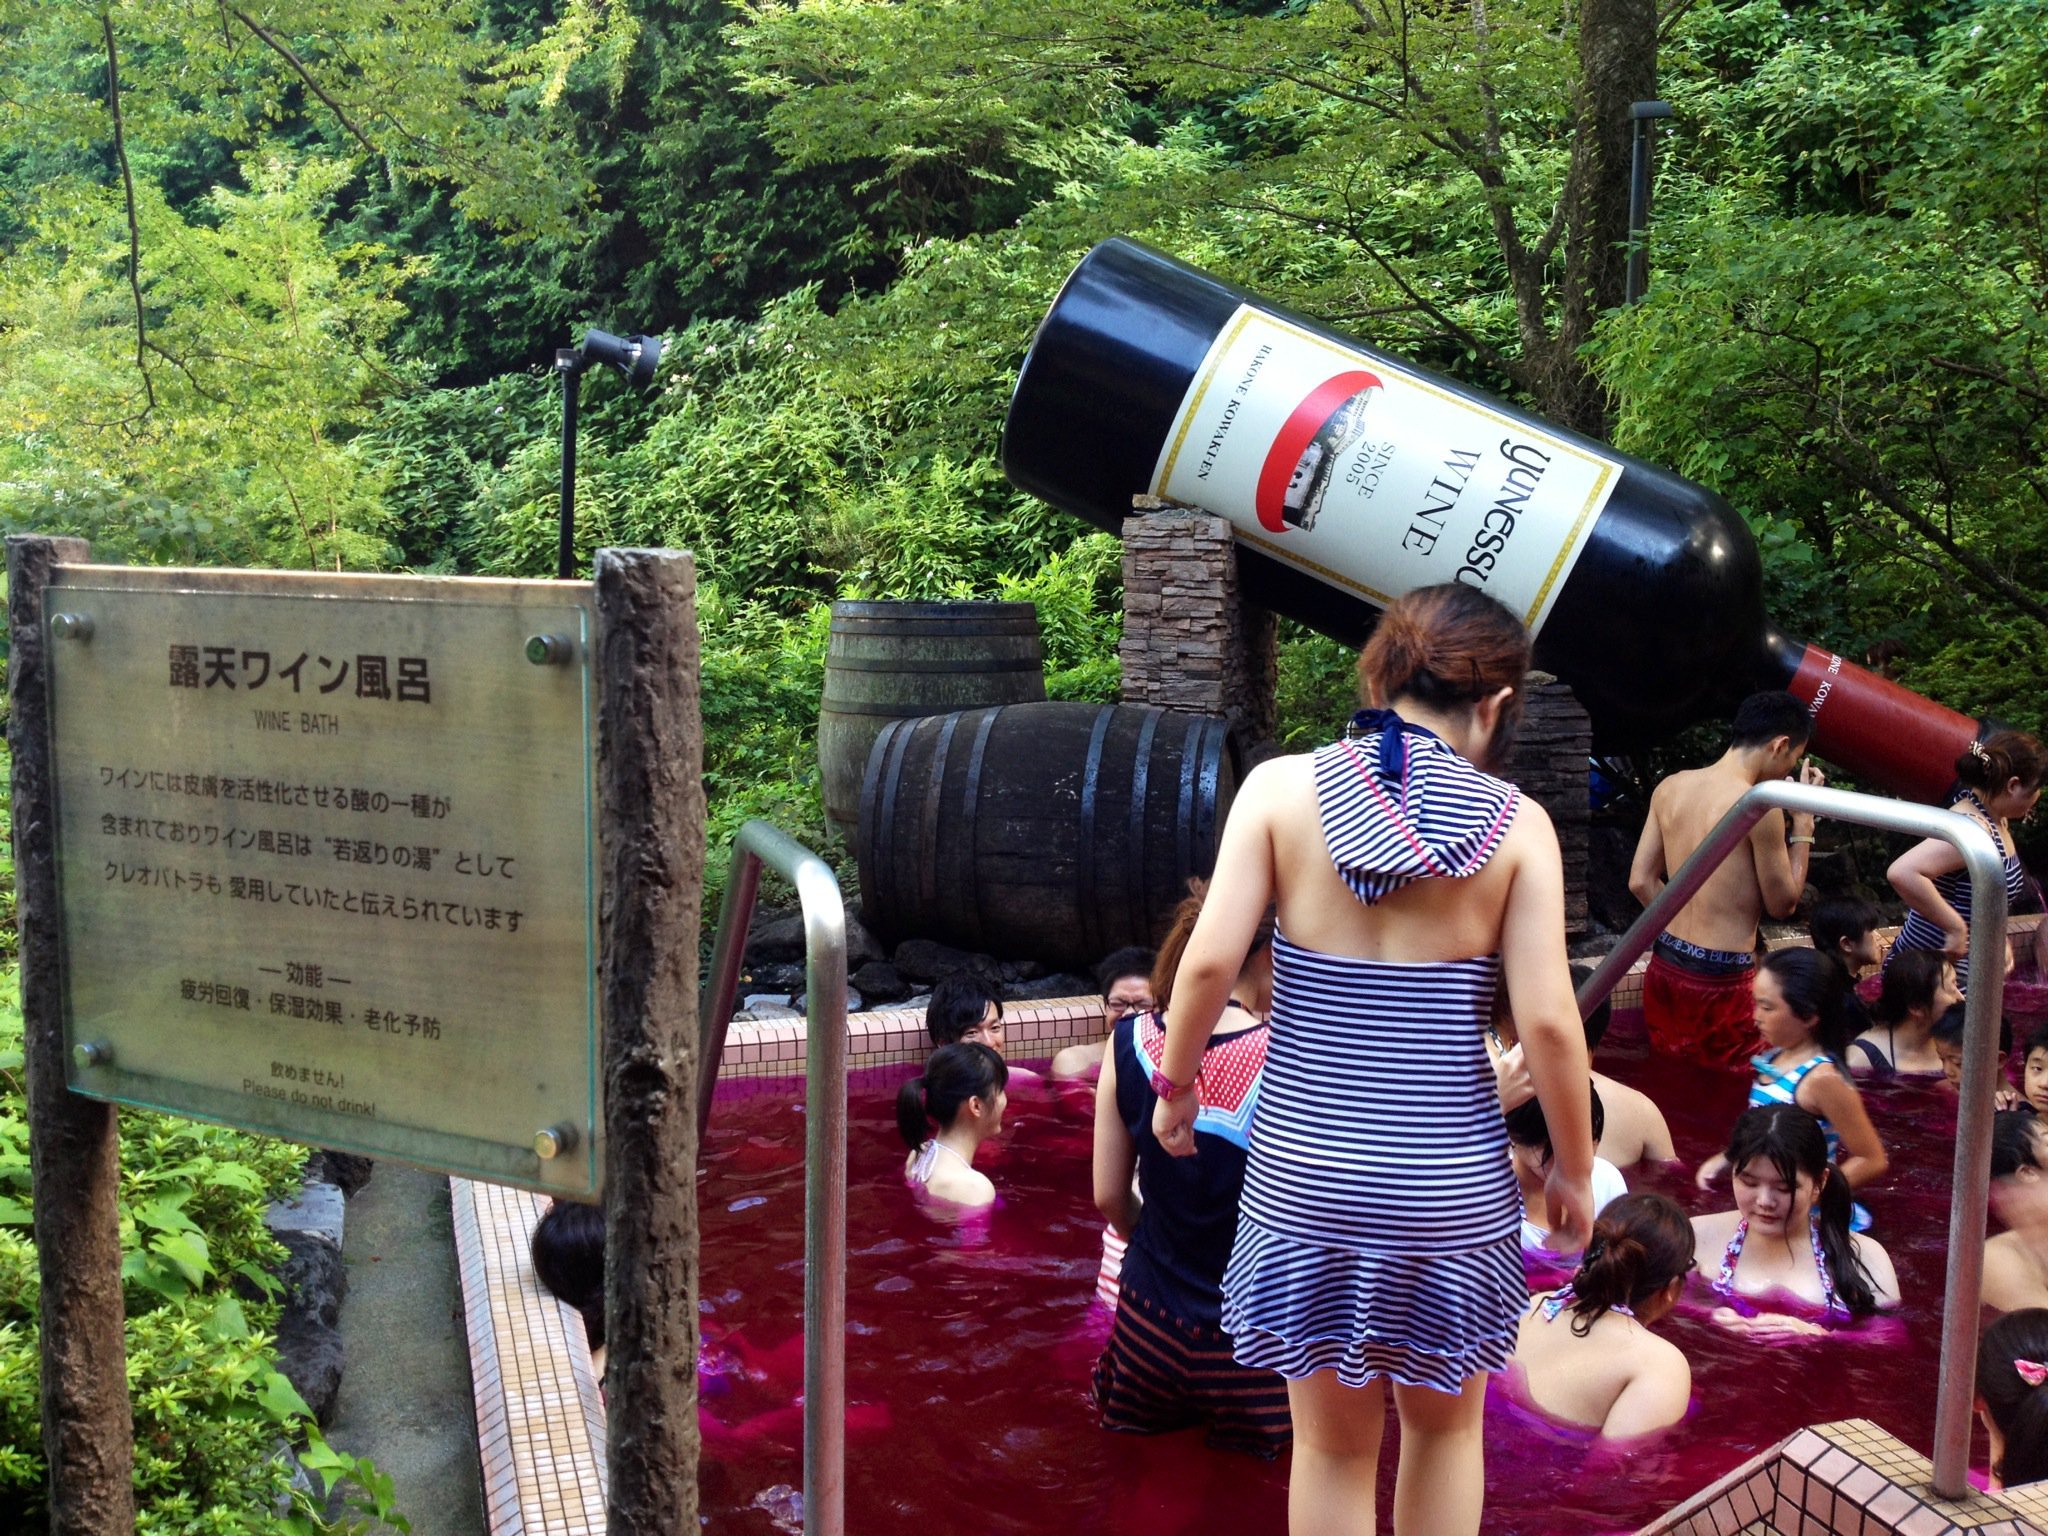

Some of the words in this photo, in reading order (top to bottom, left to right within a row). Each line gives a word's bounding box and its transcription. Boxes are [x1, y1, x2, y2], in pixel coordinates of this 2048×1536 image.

[1235, 345, 1273, 396] HAKONE
[1197, 399, 1241, 481] KOWAKI-EN
[1345, 441, 1376, 485] 2005
[1358, 441, 1396, 499] SINCE
[1401, 448, 1482, 556] WINE
[169, 644, 431, 704] 露天ワイン風呂
[1808, 680, 1832, 718] KOWA
[254, 709, 291, 732] WINE
[300, 712, 339, 735] BATH
[100, 765, 451, 820] ワインには皮膚を活性化させる酸の一種が
[243, 1079, 287, 1100] Please
[291, 1089, 308, 1105] do
[312, 1094, 333, 1110] not
[338, 1098, 376, 1118] drink!
